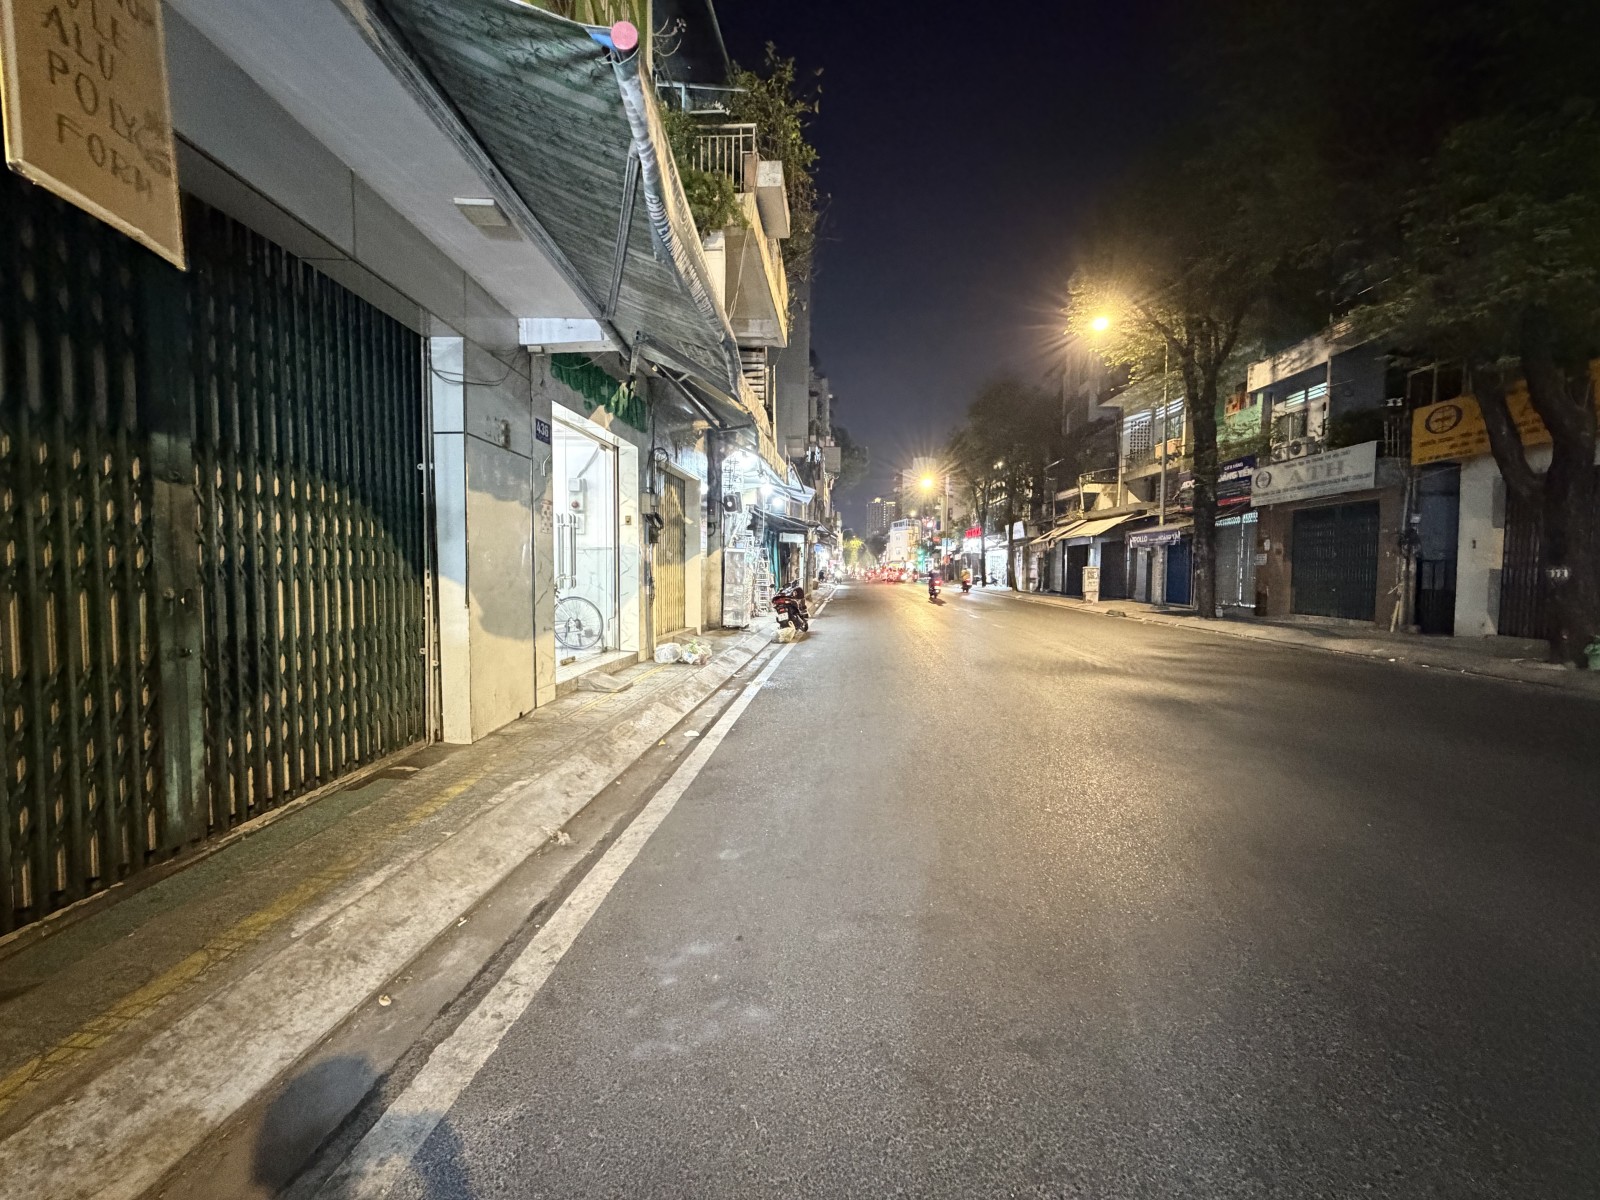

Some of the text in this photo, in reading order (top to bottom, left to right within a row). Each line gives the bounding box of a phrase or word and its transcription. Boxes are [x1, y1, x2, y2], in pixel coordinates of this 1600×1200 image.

[42, 5, 114, 81] ALU
[536, 420, 549, 438] 436
[1288, 461, 1345, 484] ATH
